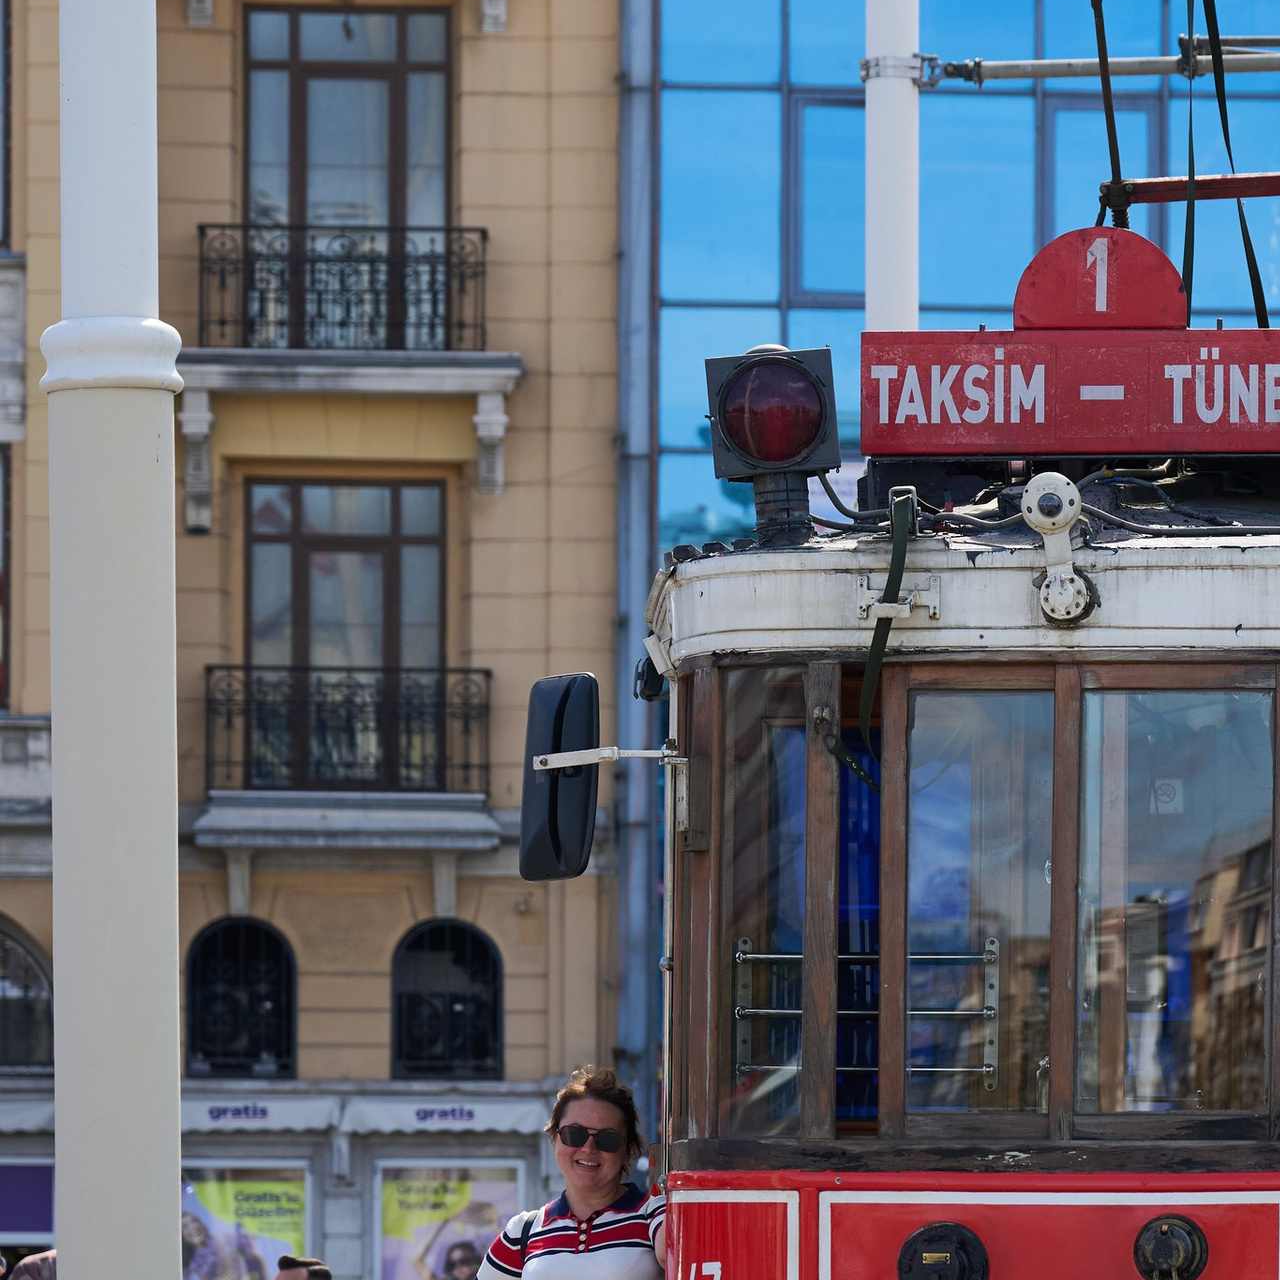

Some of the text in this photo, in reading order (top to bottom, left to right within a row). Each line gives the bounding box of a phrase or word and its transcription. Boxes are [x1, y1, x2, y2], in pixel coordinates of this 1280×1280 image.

[1086, 237, 1108, 312] 1
[870, 347, 1045, 424] TAKSİM
[208, 1102, 268, 1121] gratis
[415, 1105, 475, 1122] gratis
